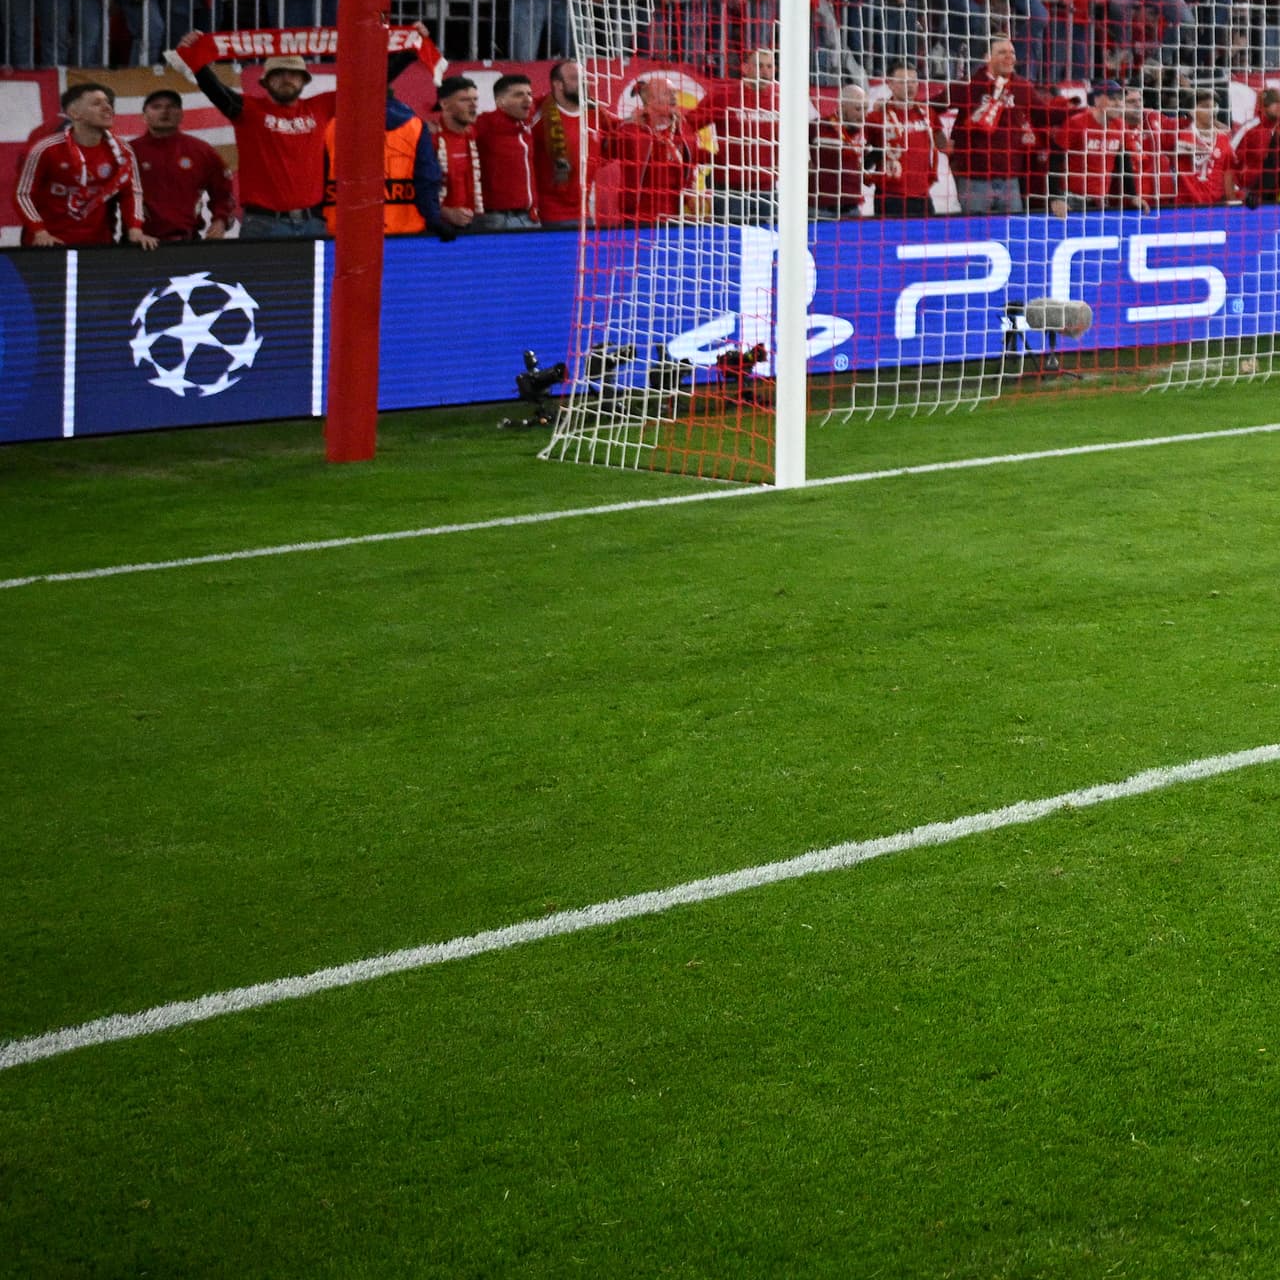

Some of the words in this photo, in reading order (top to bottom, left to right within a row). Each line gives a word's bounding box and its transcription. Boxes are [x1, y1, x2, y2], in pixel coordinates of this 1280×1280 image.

[212, 32, 275, 57] FÜR
[280, 28, 423, 56] MÜEN
[325, 182, 418, 202] SARD
[894, 230, 1227, 340] PS5
